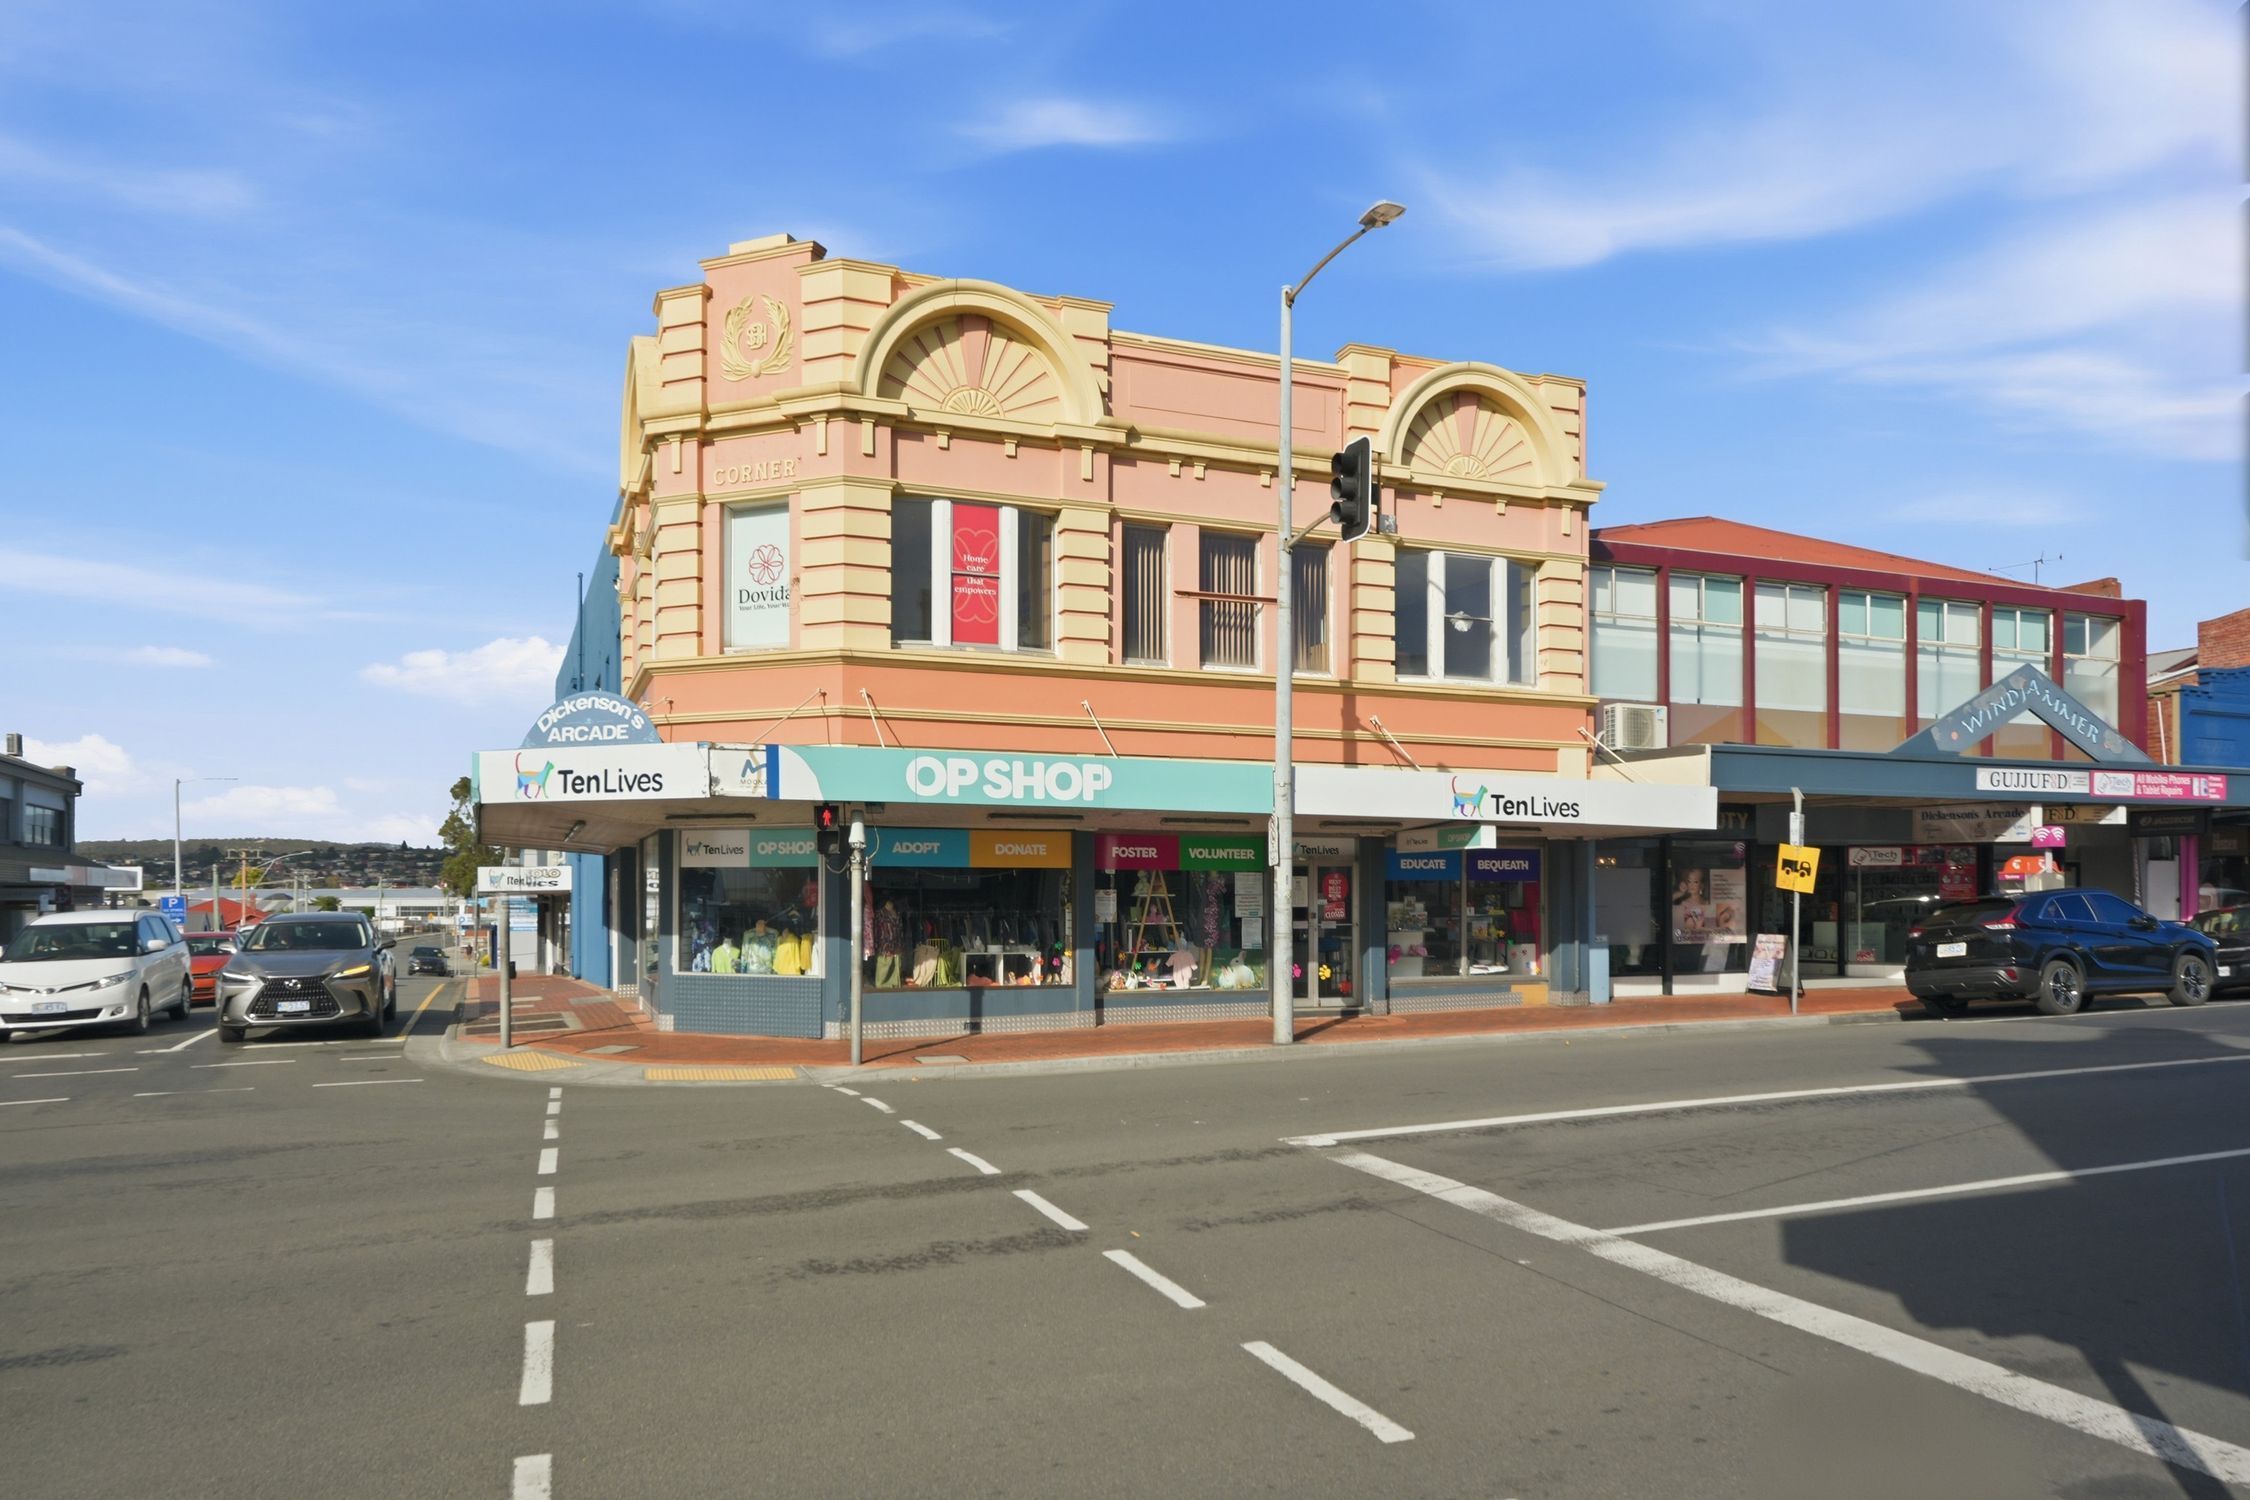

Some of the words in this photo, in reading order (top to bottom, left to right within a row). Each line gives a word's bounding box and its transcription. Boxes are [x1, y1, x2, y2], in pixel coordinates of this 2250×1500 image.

[713, 459, 797, 486] CORNER
[963, 554, 989, 564] Home
[966, 565, 985, 573] care
[966, 577, 984, 585] that
[954, 586, 997, 596] empowers
[537, 695, 645, 733] Dickenson's
[1961, 679, 2099, 744] WINDJAMMER
[547, 724, 629, 743] ARCADE
[905, 756, 979, 798] OP
[982, 759, 1113, 801] SHOP
[1984, 808, 2026, 819] Arcade
[778, 841, 815, 855] SHOP
[892, 841, 940, 855] ADOPT
[995, 842, 1047, 856] DONATE
[1112, 846, 1158, 859] FOSTER
[1189, 847, 1255, 860] VOLUNTEER
[1400, 858, 1446, 870] EDUCATE
[1477, 860, 1529, 872] BEQUEATH
[169, 898, 178, 908] P
